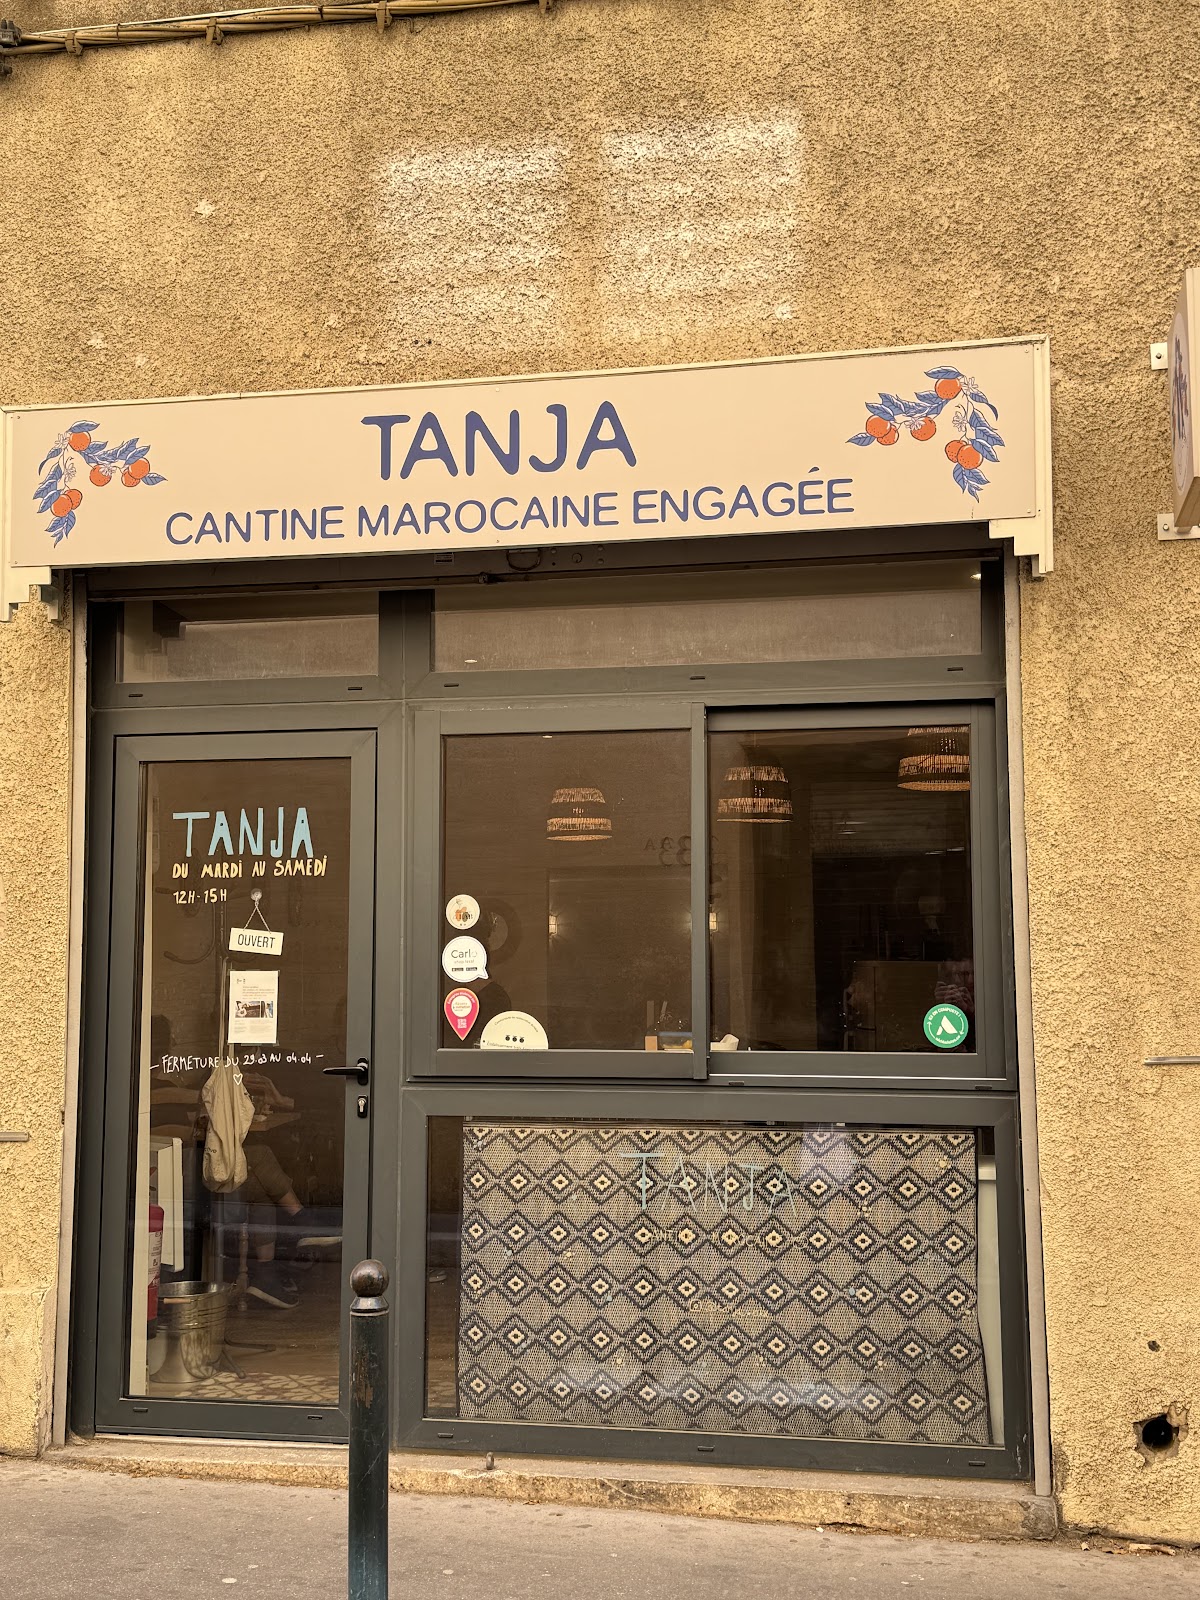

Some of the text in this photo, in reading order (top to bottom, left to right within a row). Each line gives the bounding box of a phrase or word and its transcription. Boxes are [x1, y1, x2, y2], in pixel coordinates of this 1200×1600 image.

[361, 401, 637, 480] TANJA
[166, 466, 854, 545] CANTINE MAROCAINE ENGAGÉE
[172, 806, 314, 858] TANJA
[171, 862, 190, 879] DU
[251, 860, 267, 878] AU
[237, 933, 276, 949] OUVERT
[450, 948, 478, 959] Carlo
[161, 1054, 220, 1074] FERMETURE
[224, 1056, 240, 1068] DU
[269, 1052, 282, 1063] AU
[286, 1051, 312, 1064] 04.04
[619, 1152, 797, 1217] TANJA
